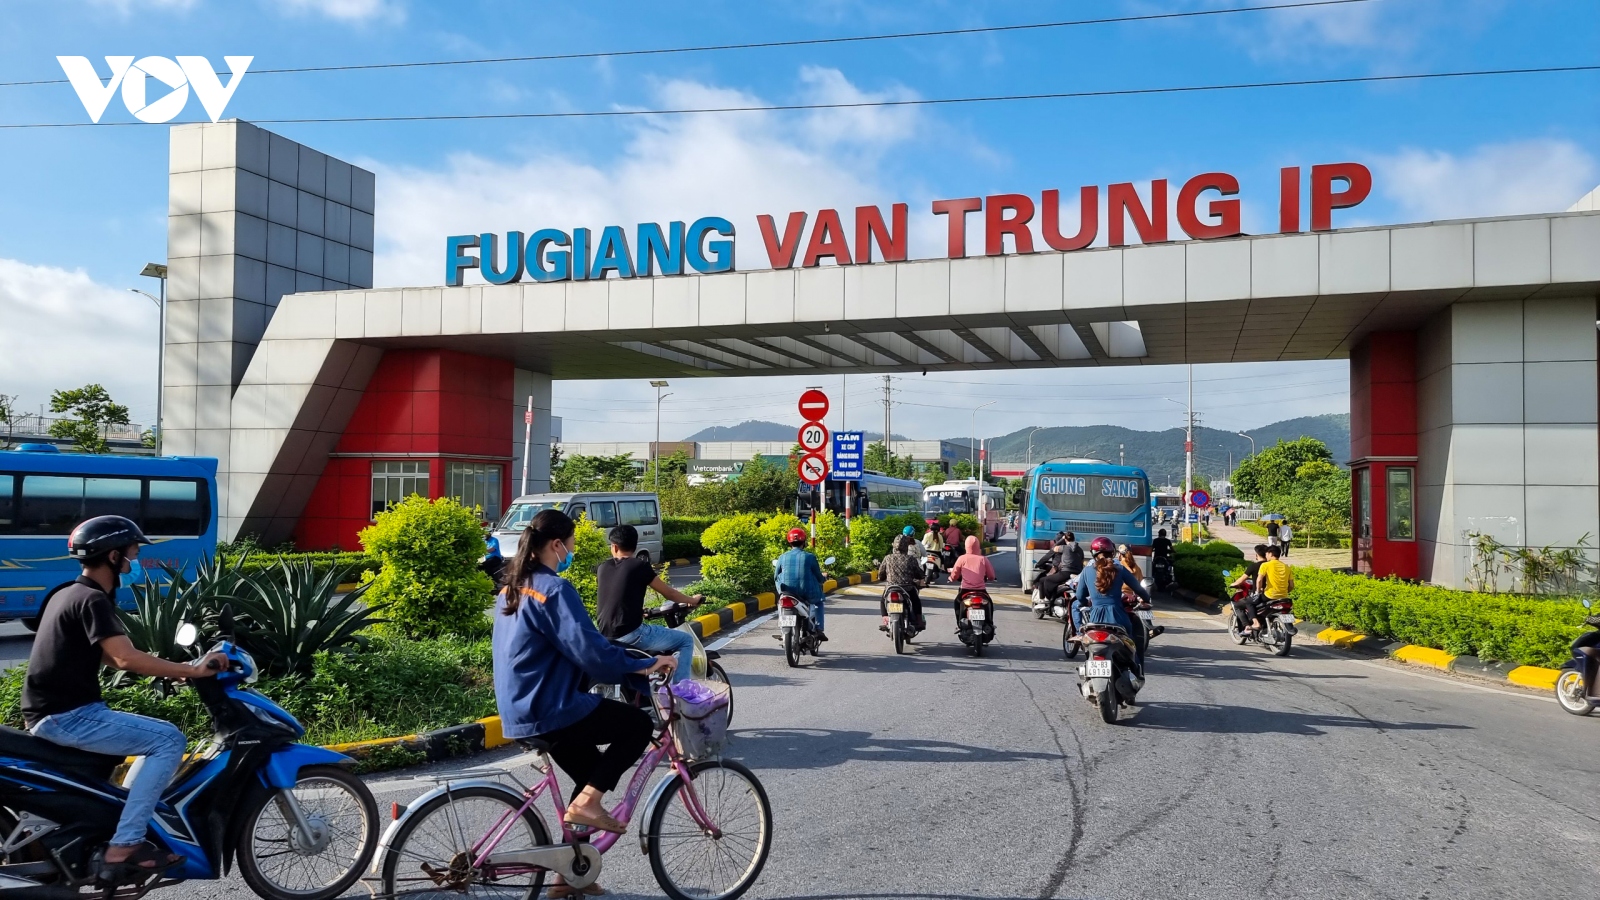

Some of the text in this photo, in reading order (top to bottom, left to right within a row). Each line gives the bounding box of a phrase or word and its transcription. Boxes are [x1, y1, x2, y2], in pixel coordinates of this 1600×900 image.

[446, 162, 1372, 286] FUGIANG VAN TRUNG IP
[805, 430, 821, 444] 20
[1040, 476, 1138, 498] CHUNG SANG
